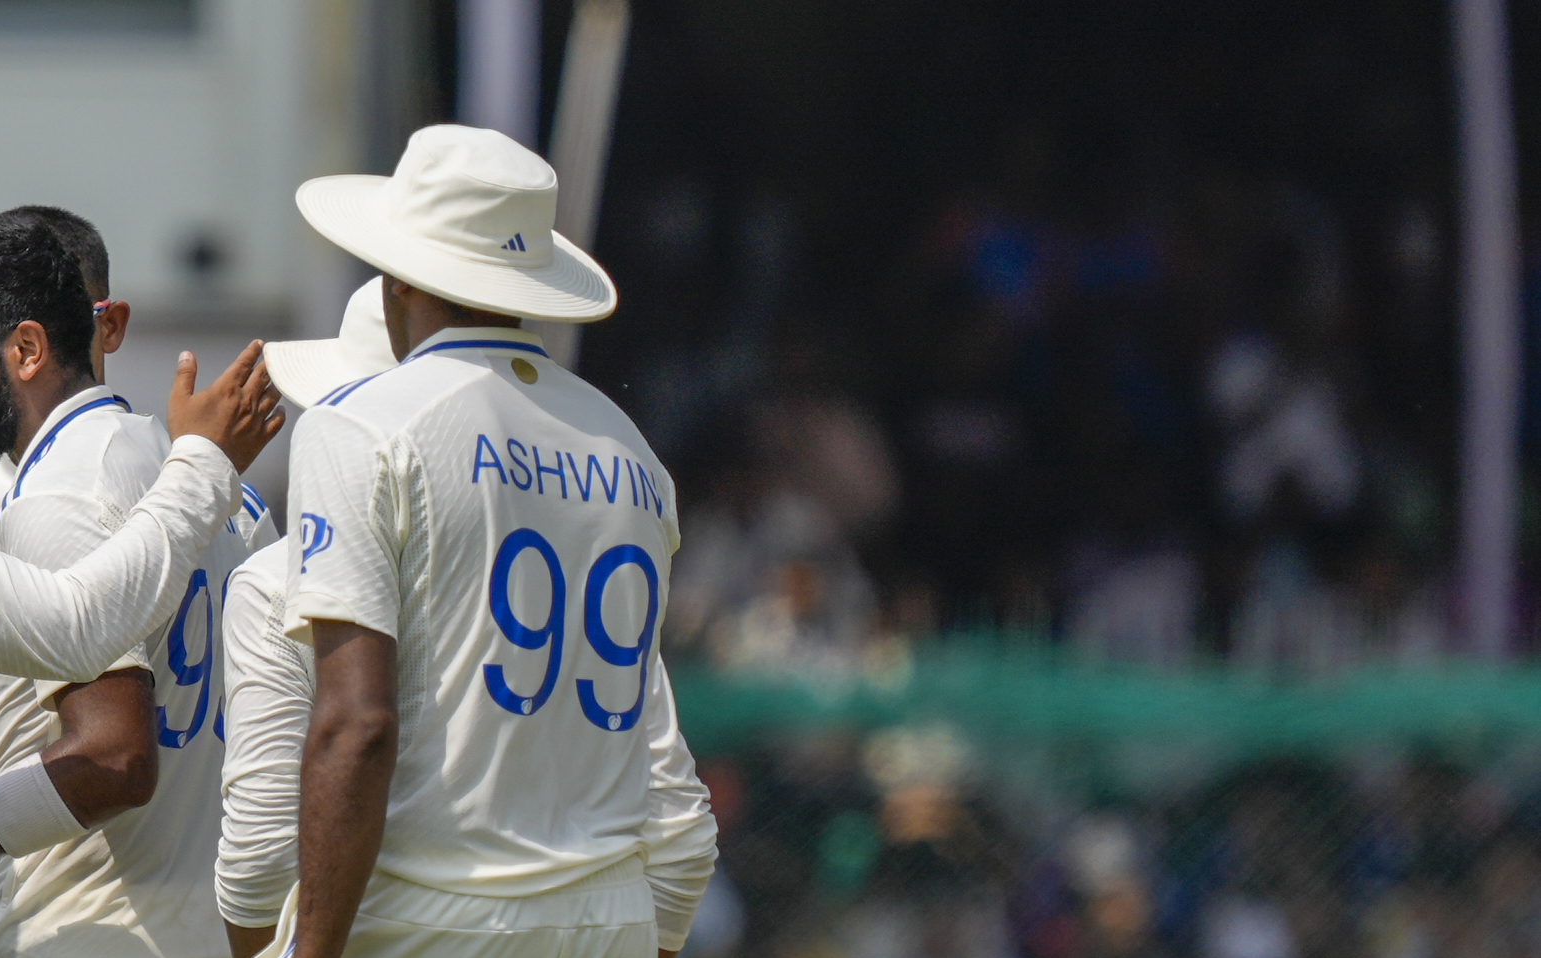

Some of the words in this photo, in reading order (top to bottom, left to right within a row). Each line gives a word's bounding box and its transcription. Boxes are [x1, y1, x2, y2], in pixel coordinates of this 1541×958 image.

[472, 434, 662, 519] ASHWIN
[156, 568, 226, 749] 9
[482, 527, 659, 732] 99
